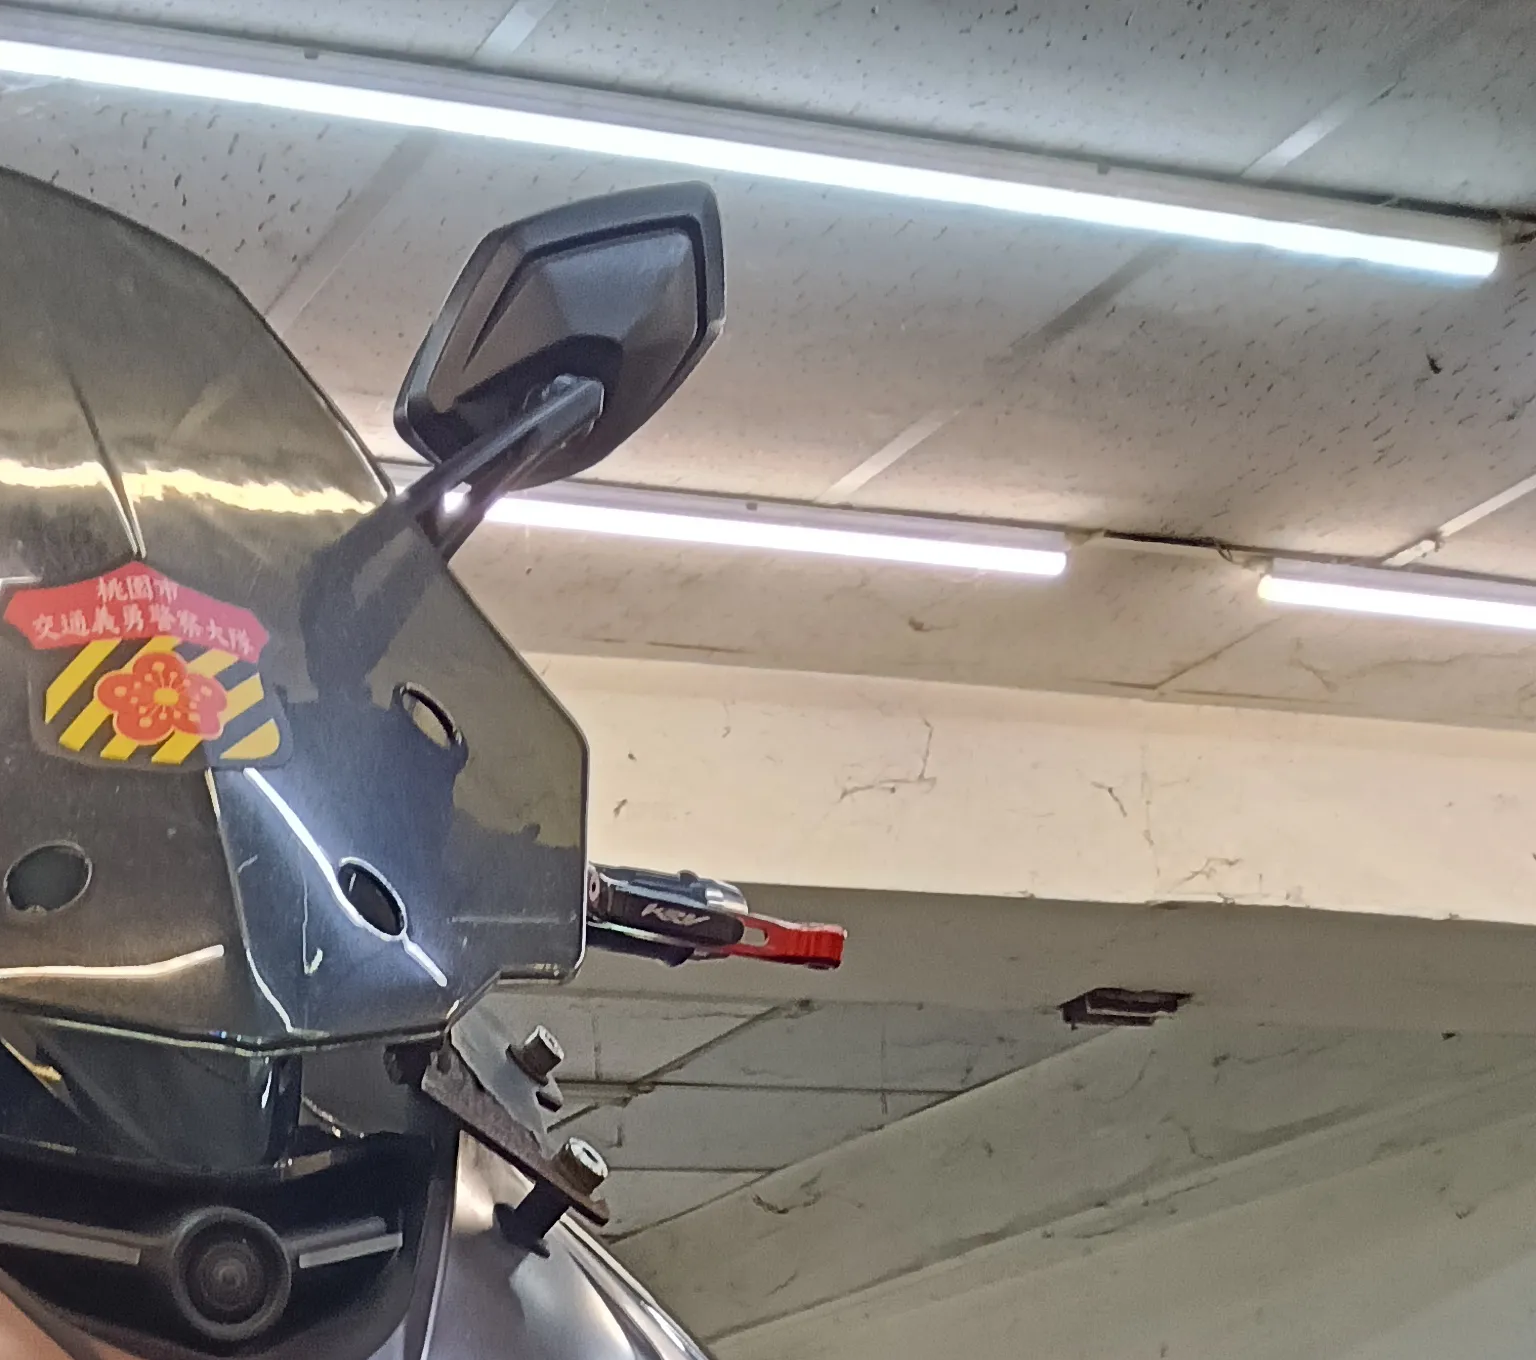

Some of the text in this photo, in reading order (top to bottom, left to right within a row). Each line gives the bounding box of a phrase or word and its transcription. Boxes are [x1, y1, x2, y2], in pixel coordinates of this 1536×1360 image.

[97, 575, 178, 604] 桃園市
[32, 604, 254, 655] 交通義勇警察大隊
